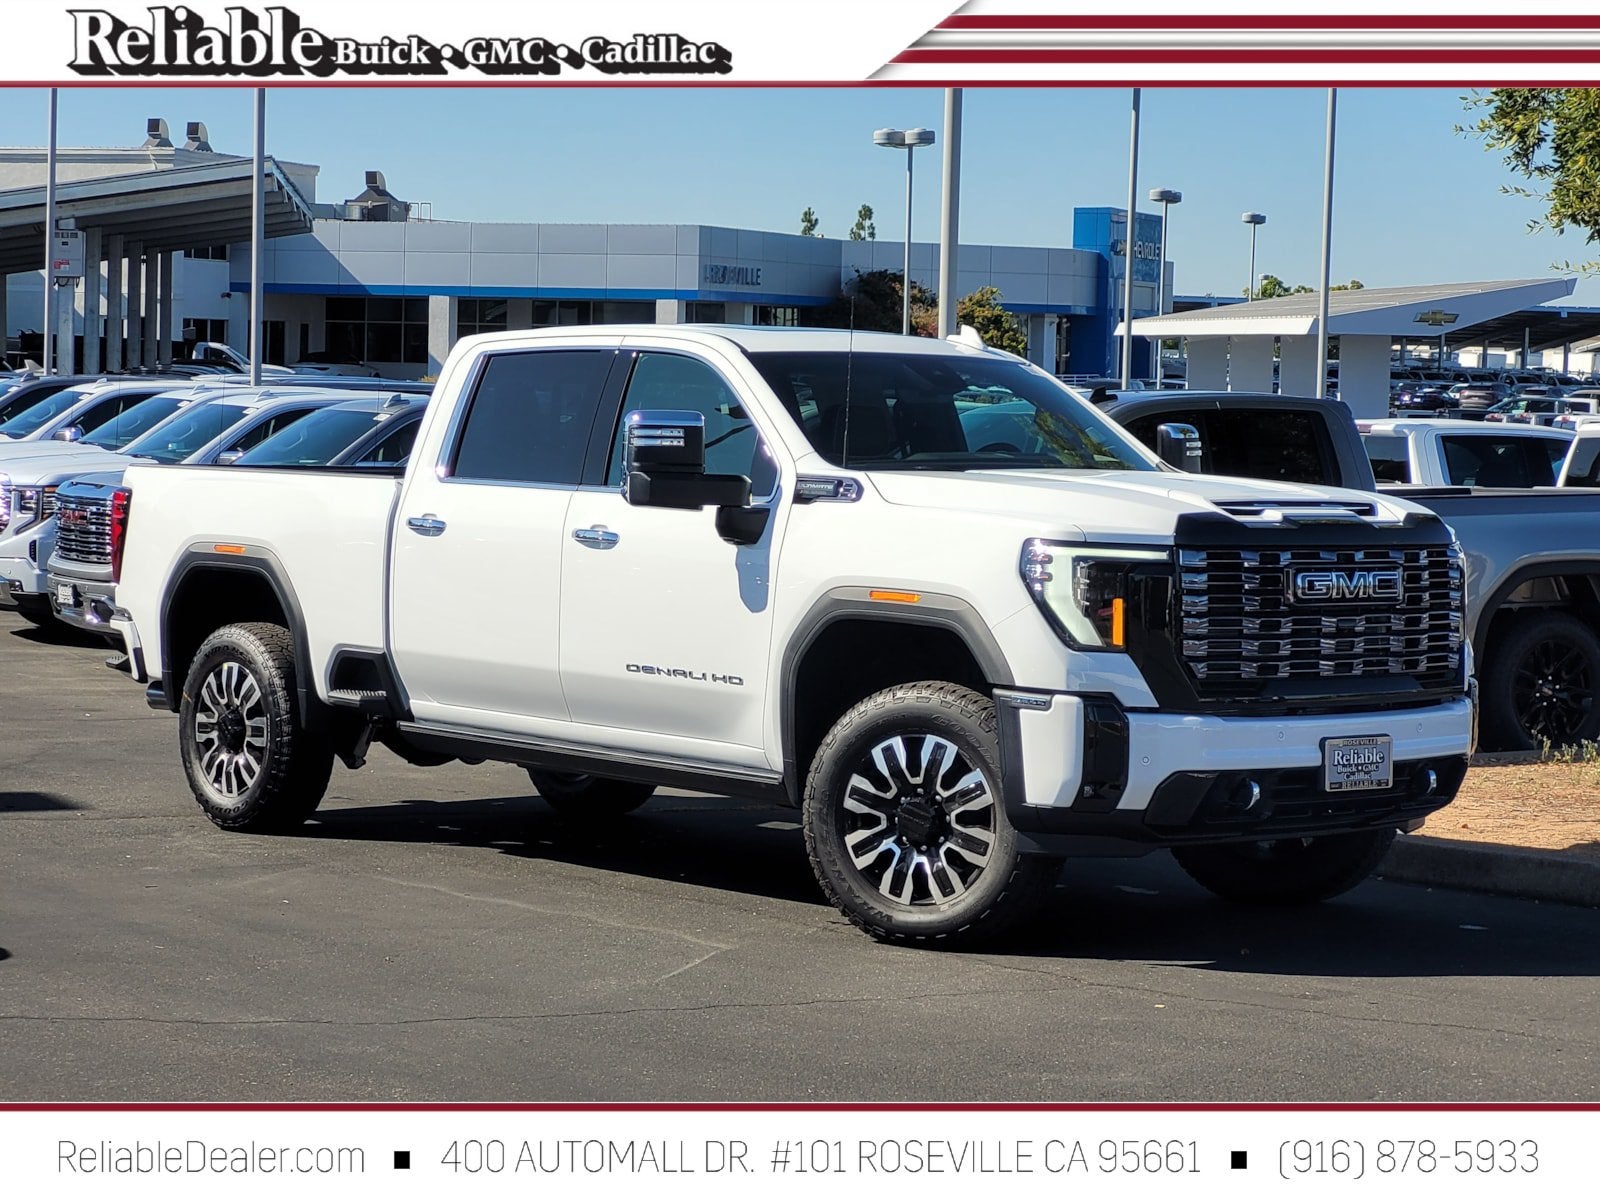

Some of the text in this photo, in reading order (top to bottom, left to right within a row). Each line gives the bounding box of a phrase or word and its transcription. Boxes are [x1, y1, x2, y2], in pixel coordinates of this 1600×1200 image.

[1134, 241, 1162, 260] HEVROLE
[1297, 571, 1399, 599] GMC
[626, 663, 744, 686] DENALI HD
[1333, 747, 1385, 765] Reliable
[1337, 763, 1380, 773] Buick GMC
[1343, 771, 1372, 781] Cadillac
[1342, 780, 1379, 790] RELIABLE
